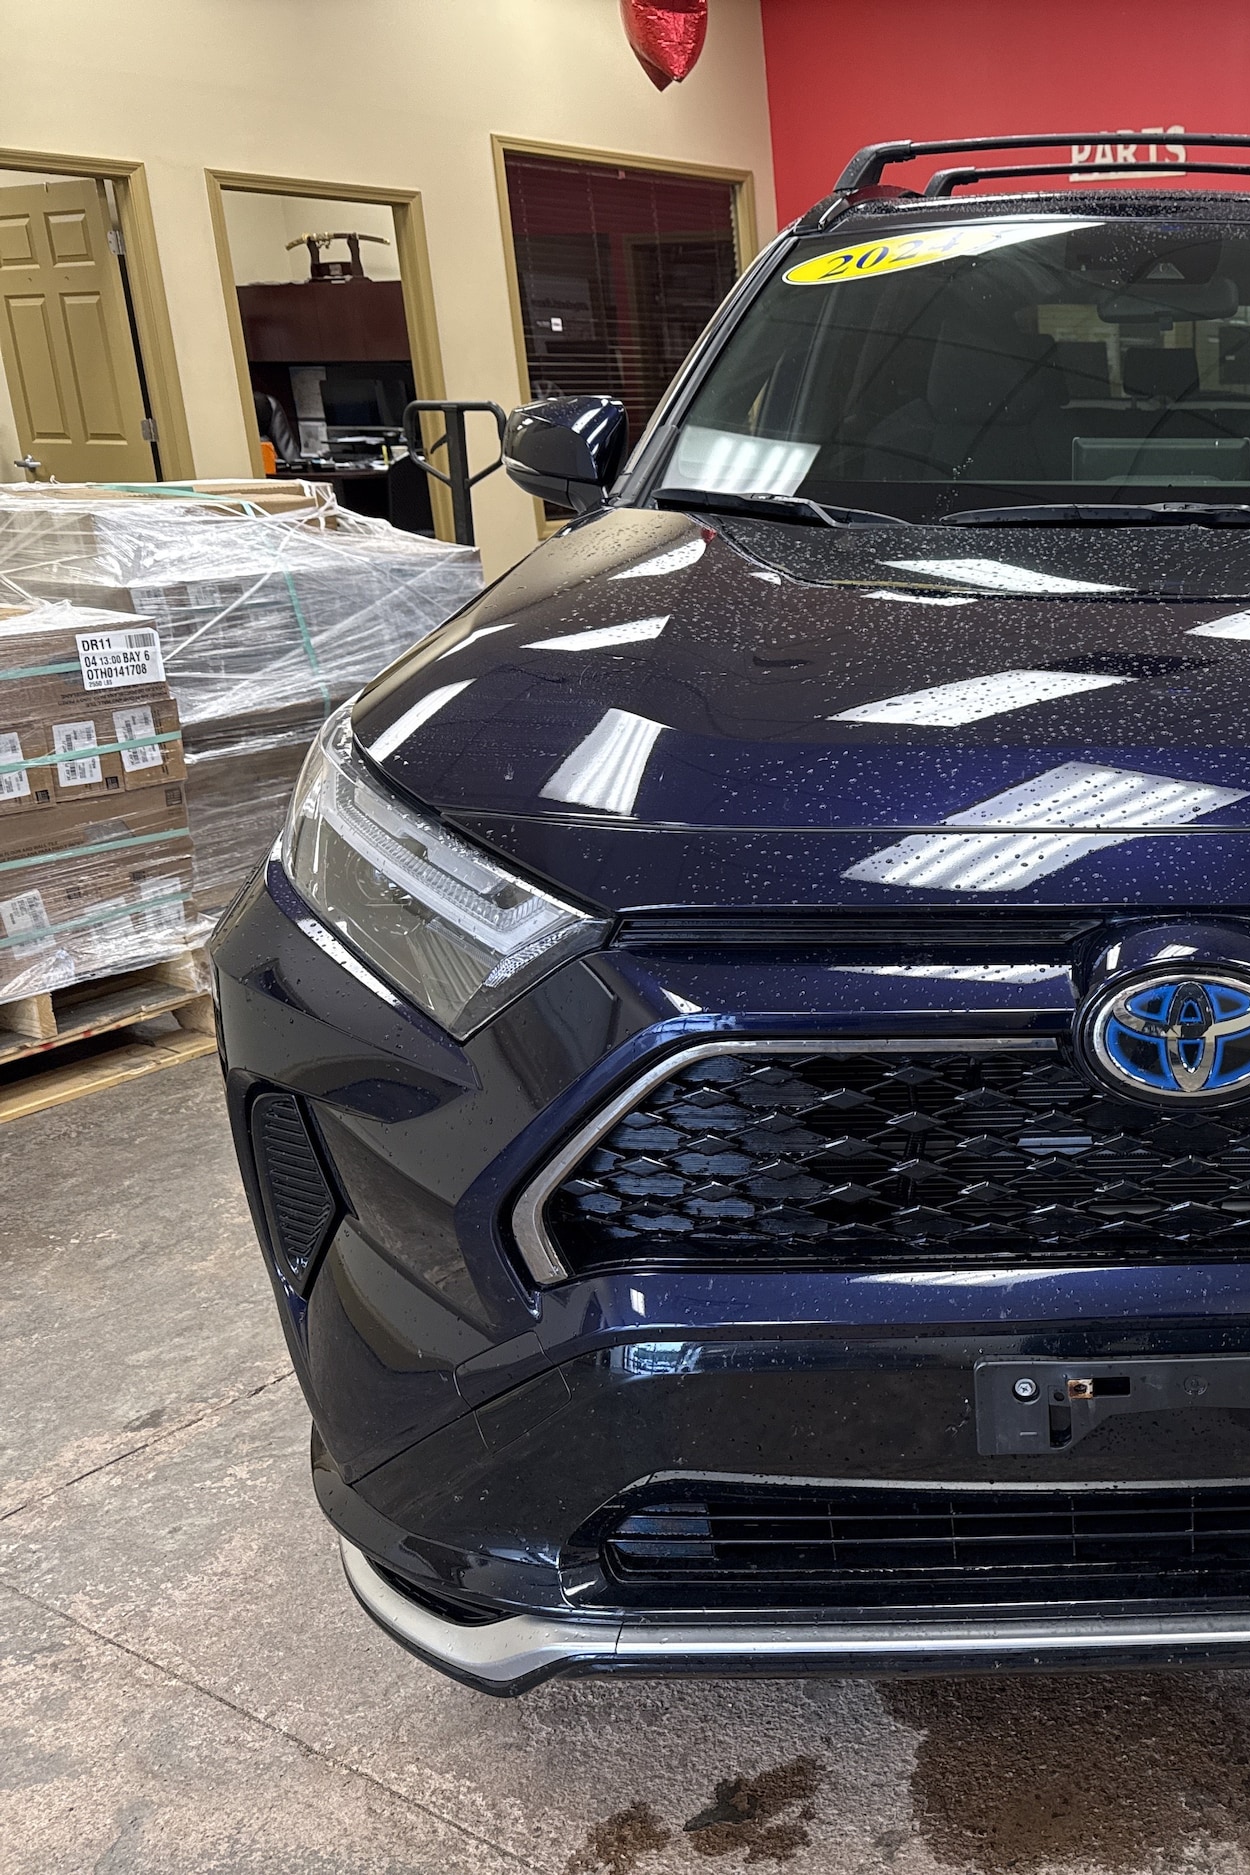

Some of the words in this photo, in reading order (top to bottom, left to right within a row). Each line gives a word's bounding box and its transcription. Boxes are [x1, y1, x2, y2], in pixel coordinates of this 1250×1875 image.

[1069, 125, 1187, 175] PARTS
[817, 231, 965, 280] 2024
[82, 637, 112, 652] DR11
[84, 655, 98, 668] 04
[99, 655, 122, 666] 13:00
[122, 650, 141, 664] BAY
[144, 650, 150, 661] 6
